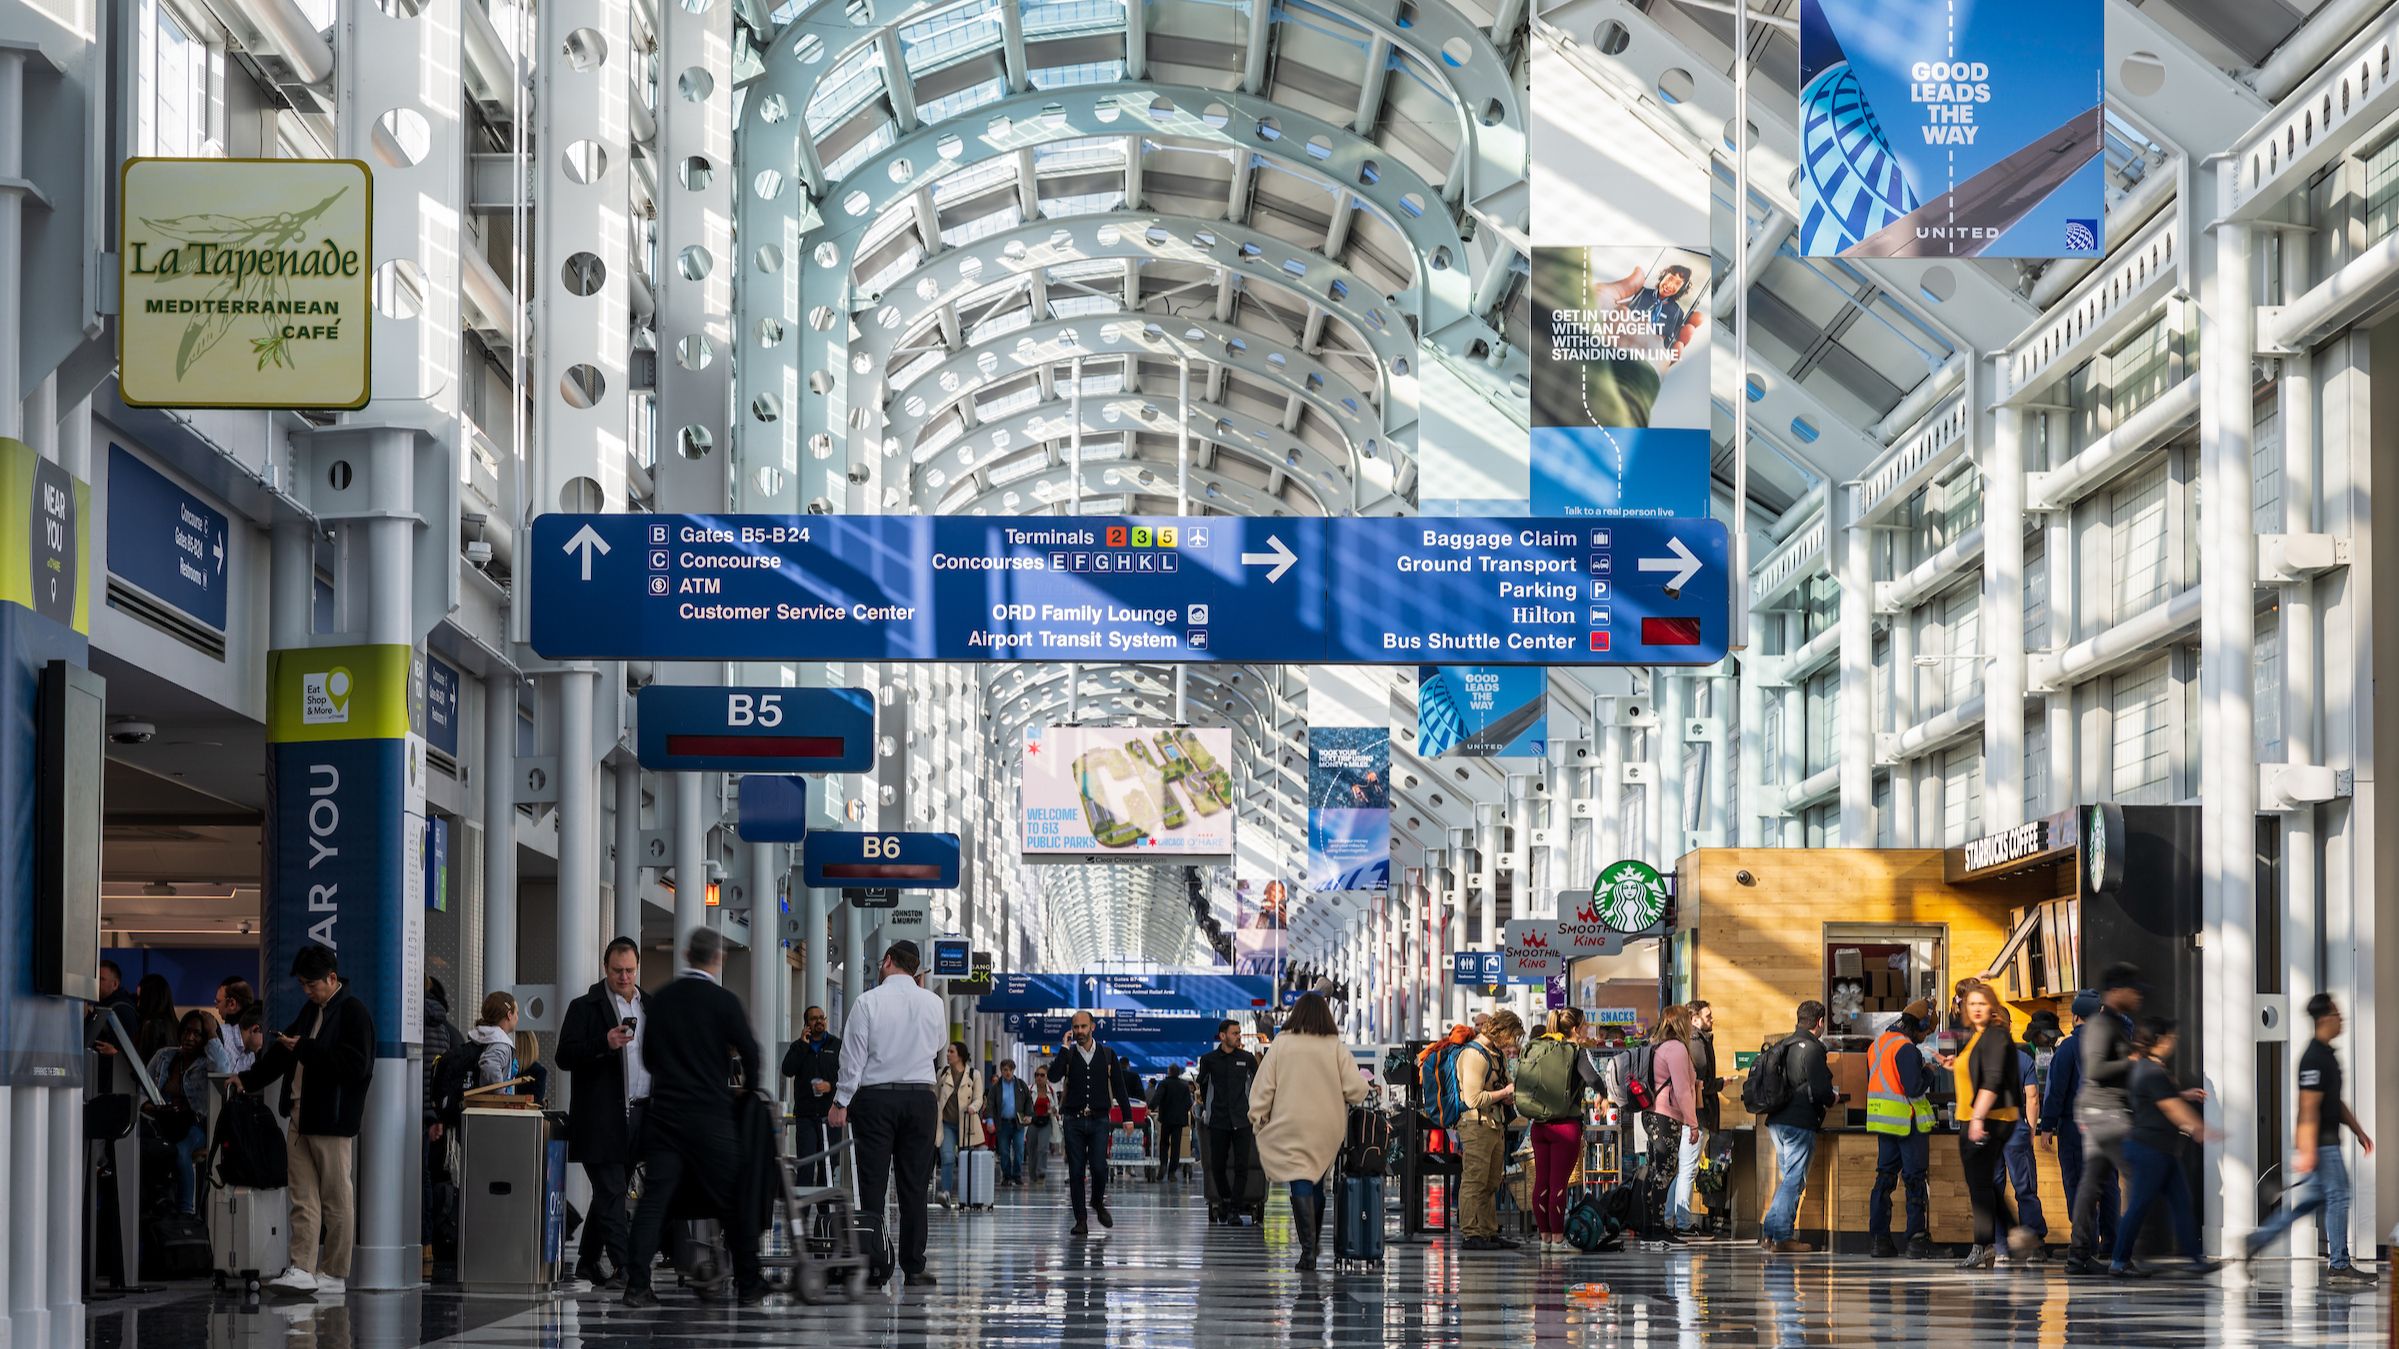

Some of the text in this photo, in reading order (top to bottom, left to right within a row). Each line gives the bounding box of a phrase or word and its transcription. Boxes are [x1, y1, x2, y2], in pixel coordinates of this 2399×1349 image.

[1911, 62, 1989, 82] GOOD
[1910, 83, 1991, 103] LEADS
[1927, 104, 1974, 124] THE
[1922, 126, 1979, 145] WAY
[1916, 226, 2000, 239] UNITED
[130, 238, 359, 289] La Tapenade
[145, 299, 340, 315] MEDITERRANEAN
[1552, 310, 1652, 322] GET IN TOUCH
[281, 318, 342, 340] CAFÉ
[1552, 322, 1666, 335] WITH AN AGENT
[1552, 336, 1620, 348] WITHOUT
[1552, 348, 1682, 361] STANDING IN LINE.
[44, 482, 66, 520] NEAR
[181, 502, 203, 532] Concourse
[1564, 506, 1582, 516] Talk
[1584, 507, 1594, 516] to
[1603, 507, 1622, 516] real
[1622, 508, 1656, 518] person
[1658, 508, 1674, 516] live
[46, 517, 62, 552] YOU
[175, 526, 188, 550] Gates
[652, 526, 810, 544] B Gates B5-B24
[1005, 528, 1173, 545] Terminals 2 3 5
[1423, 530, 1578, 550] Baggage Claim
[652, 552, 782, 568] C Concourse
[931, 553, 1174, 570] Concourses E F G H K L
[1397, 556, 1578, 576] Ground Transport
[180, 556, 202, 586] Restrooms
[679, 578, 721, 594] ATM
[1500, 582, 1606, 602] Parking P
[680, 602, 916, 620] Customer Service Center
[992, 604, 1178, 626] ORD Family Lounge
[1512, 606, 1577, 624] Hilton
[968, 630, 1178, 652] Airport Transit System
[1383, 632, 1577, 650] Bus Shuttle Center
[1465, 674, 1499, 683] GOOD
[307, 684, 320, 694] Eat
[1465, 683, 1500, 692] LEADS
[307, 695, 327, 706] Shop
[1472, 692, 1493, 701] THE
[307, 706, 332, 716] & More
[728, 694, 783, 728] B5
[1470, 701, 1494, 710] WAY
[308, 764, 340, 870] YOU
[1026, 808, 1078, 820] WELCOME
[1026, 822, 1059, 834] TO 613
[863, 836, 900, 859] B6
[1026, 836, 1096, 849] PUBLIC PARKS
[1964, 820, 2039, 872] STARBUCKS COFFEE
[1142, 856, 1167, 865] Airports
[892, 910, 923, 918] JOHNSTON
[1584, 1010, 1635, 1022] TY SNACKS
